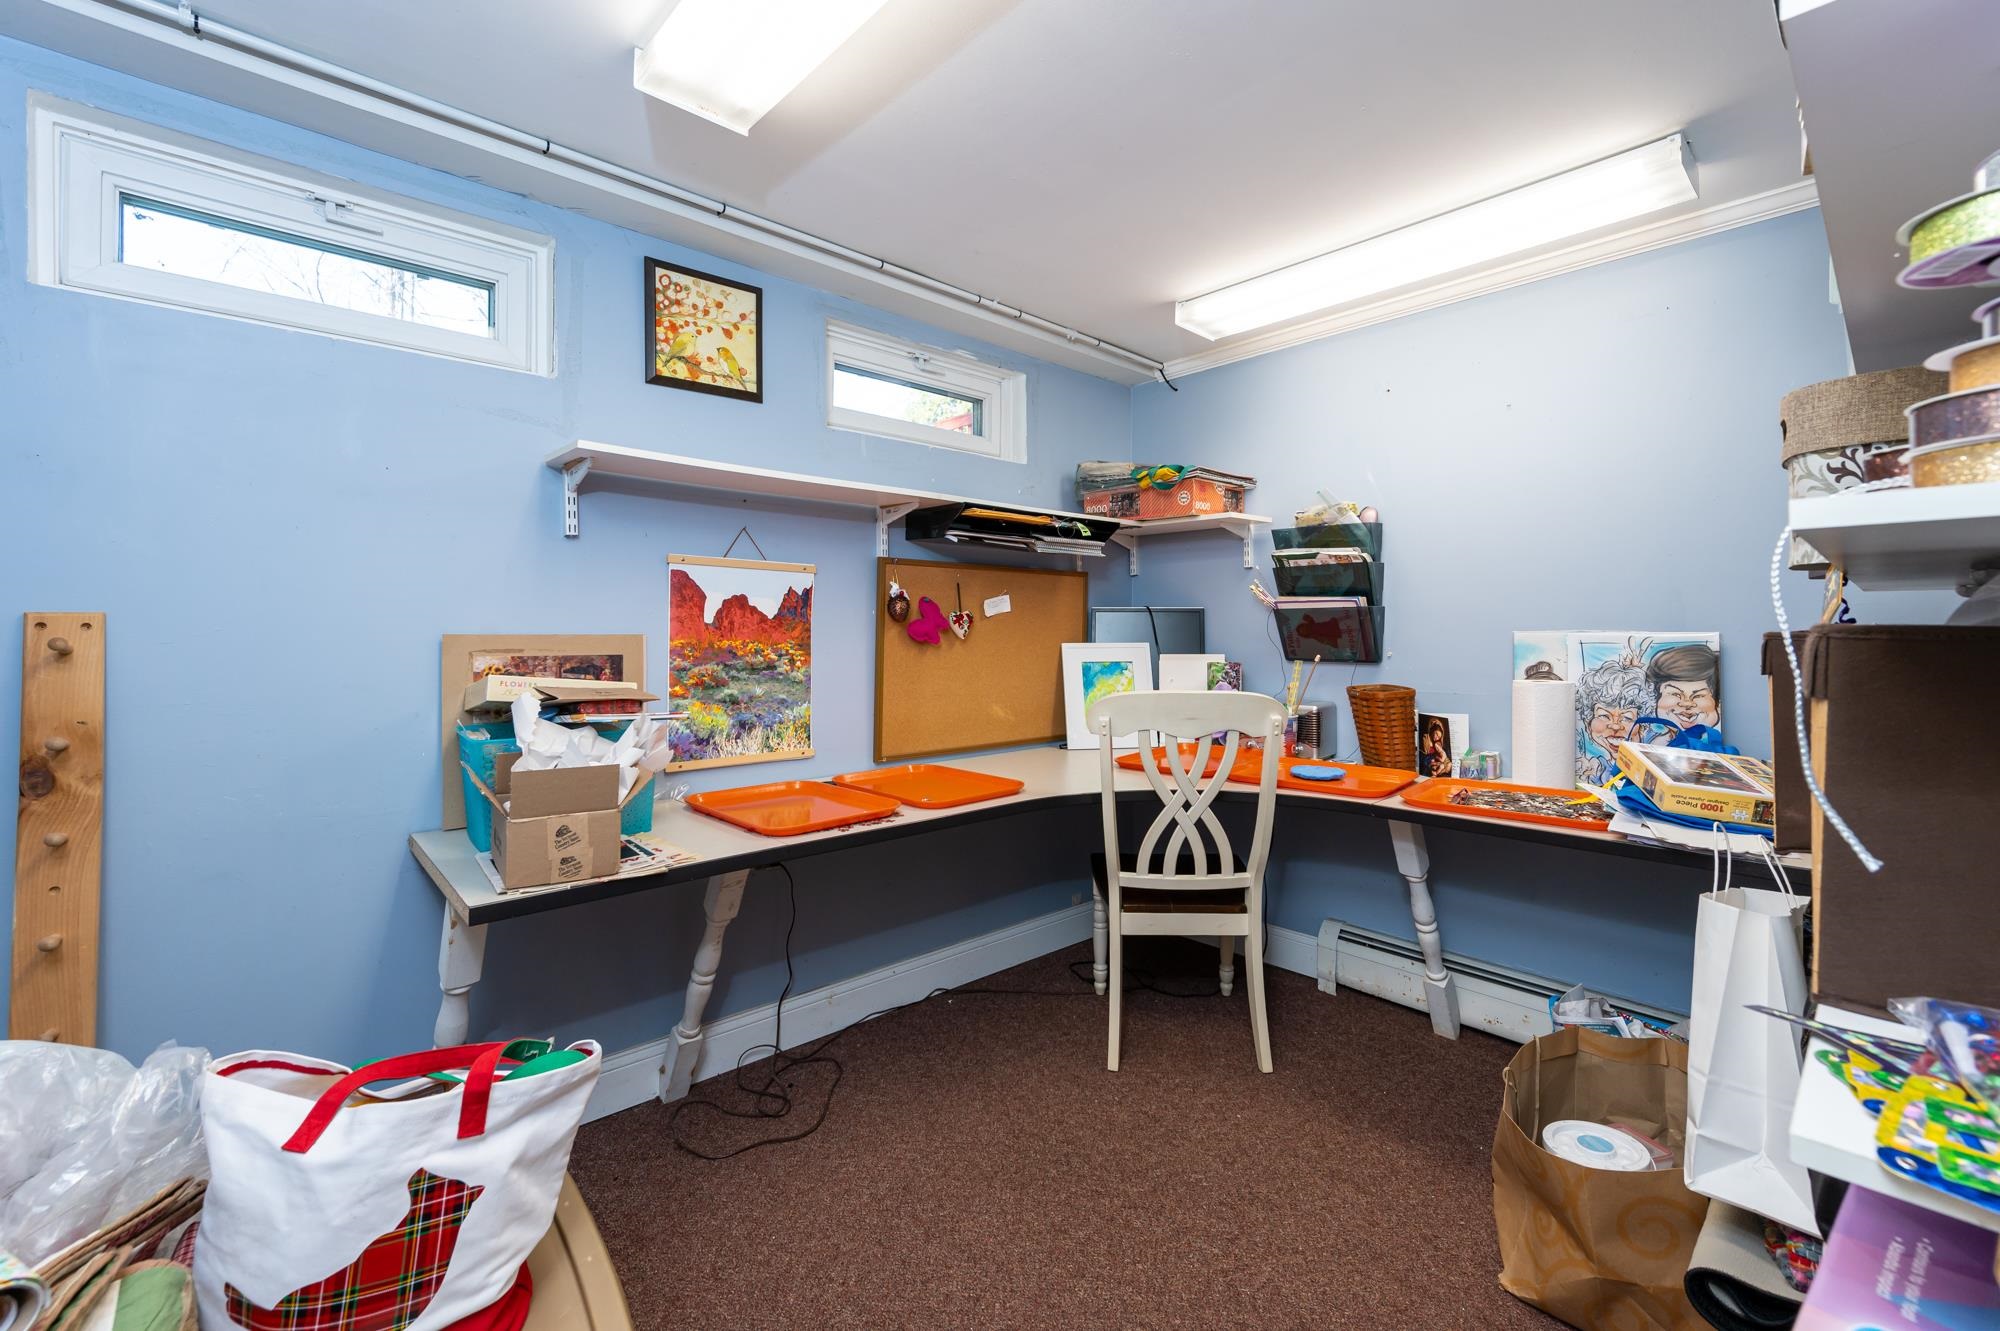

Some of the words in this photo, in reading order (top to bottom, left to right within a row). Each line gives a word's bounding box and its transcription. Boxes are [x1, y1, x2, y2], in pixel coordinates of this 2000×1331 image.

[1195, 501, 1211, 511] 8000
[1675, 799, 1698, 809] Piece
[1700, 803, 1725, 813] 1000
